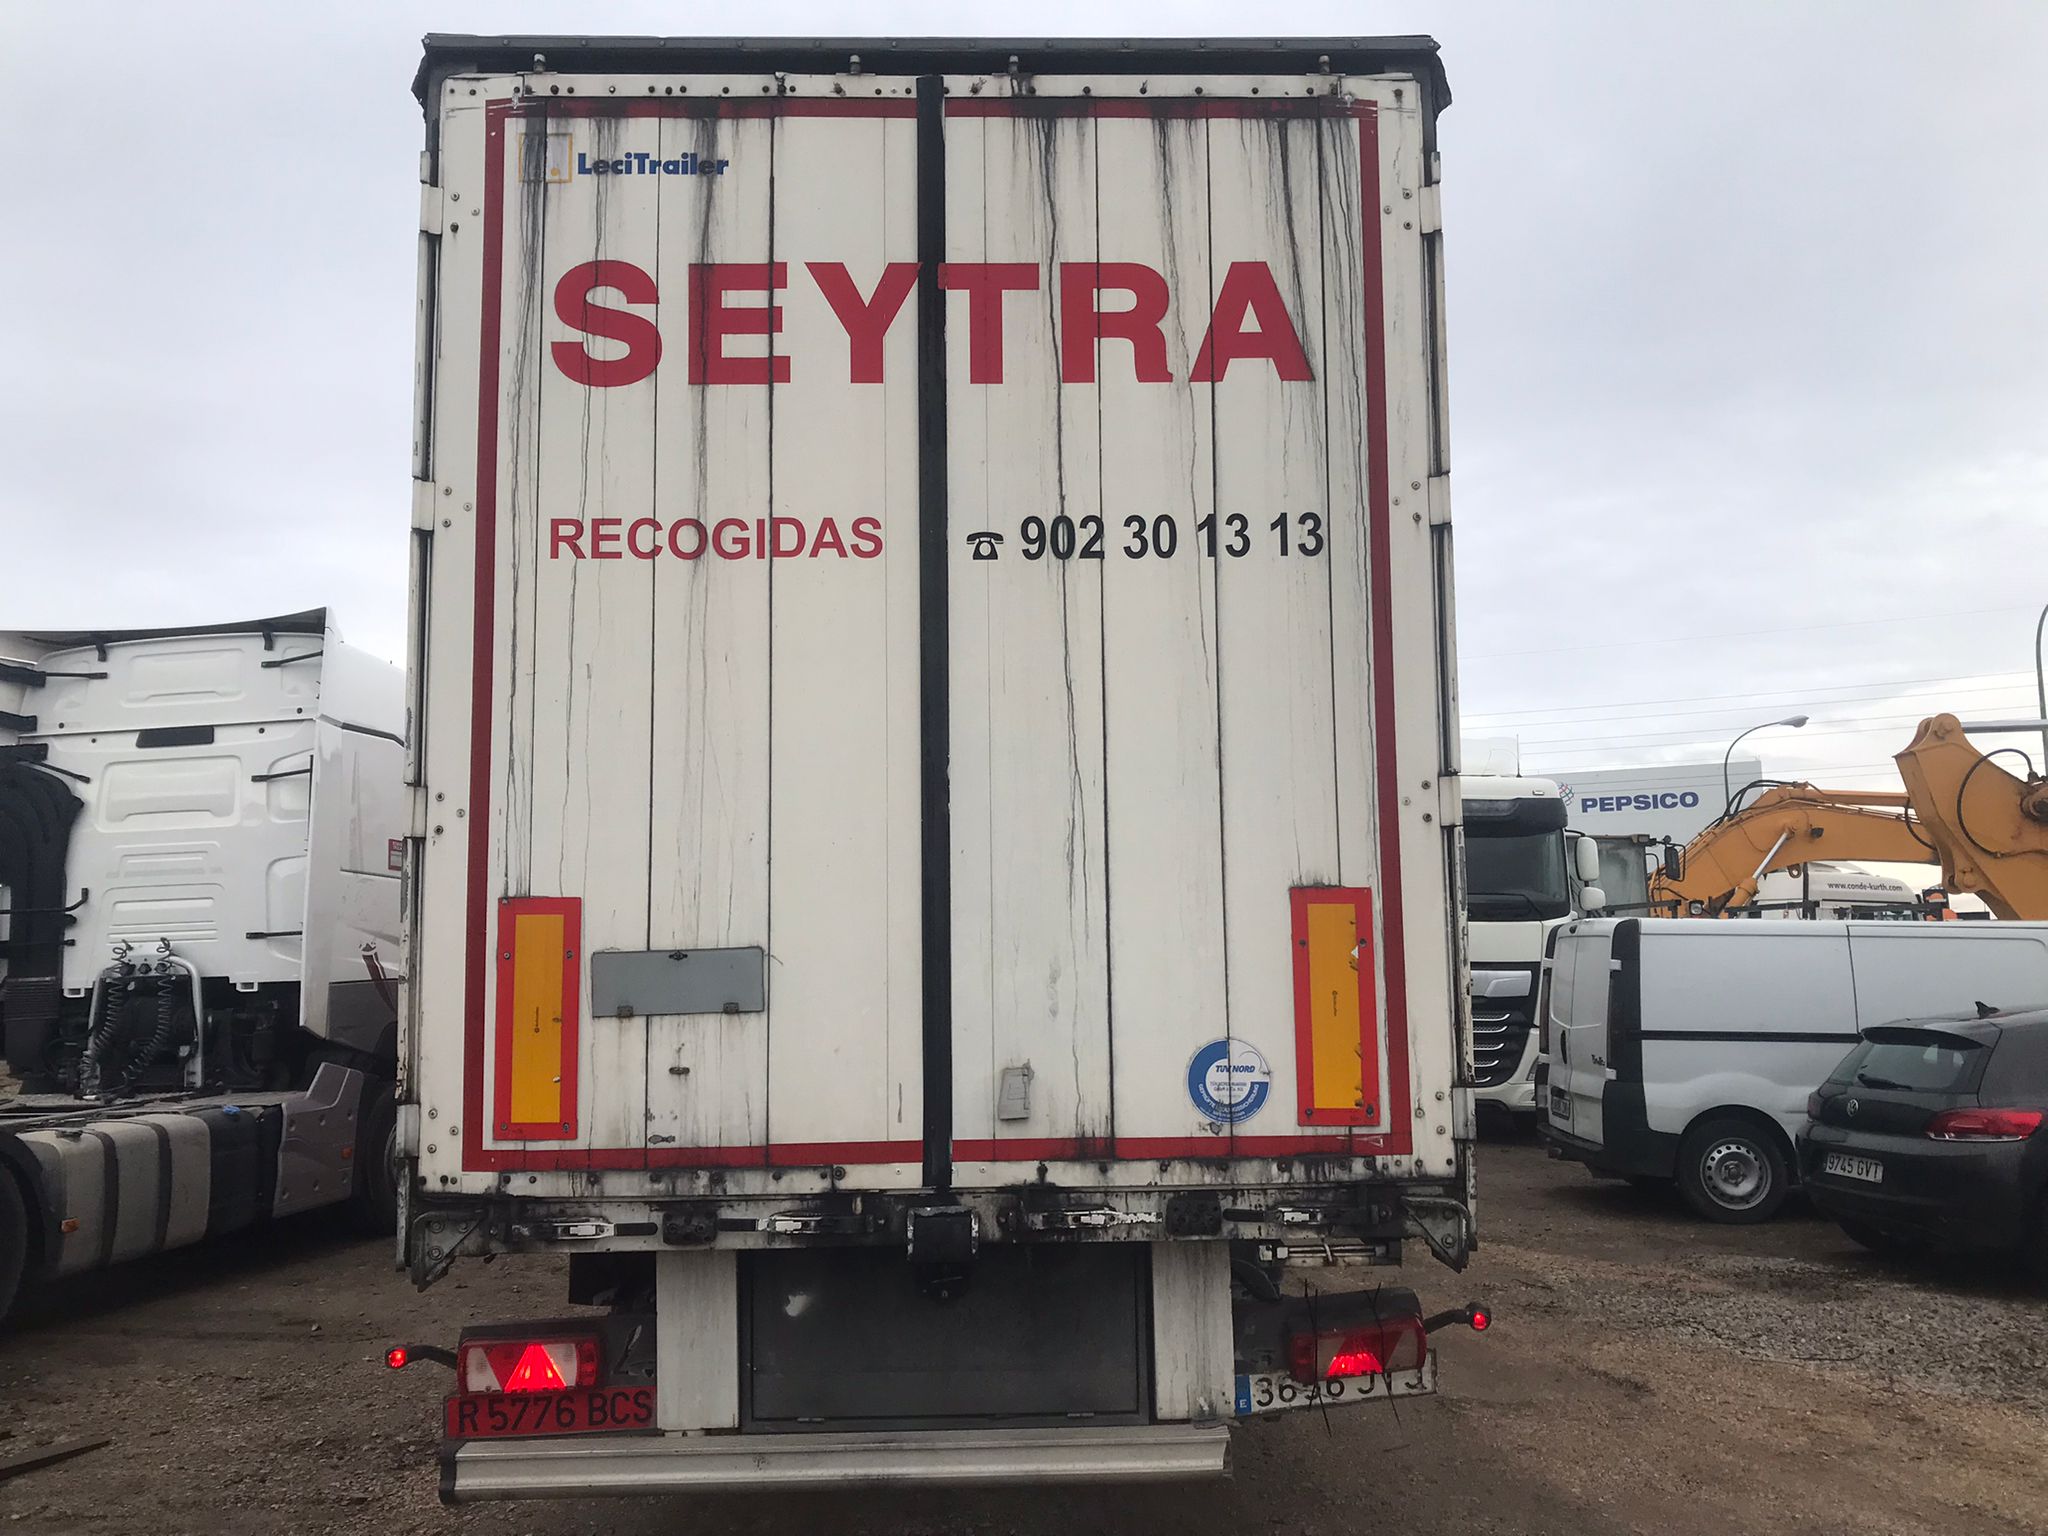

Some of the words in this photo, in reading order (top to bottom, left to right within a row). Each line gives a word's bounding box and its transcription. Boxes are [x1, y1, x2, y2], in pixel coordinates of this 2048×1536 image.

[577, 152, 730, 175] LeciTrailer
[551, 259, 1315, 386] SEYTRA
[550, 516, 884, 560] RECOGIDAS
[1020, 515, 1106, 560] 902
[1123, 514, 1179, 559] 30
[1196, 513, 1251, 558] 13
[1270, 512, 1325, 557] 13
[1581, 791, 1699, 814] PEPSICO
[1827, 881, 1904, 892] www.conde-kurth.com
[1232, 1065, 1256, 1073] NORD
[1828, 1155, 1854, 1174] 9745
[1856, 1160, 1881, 1179] GVT
[458, 1401, 479, 1433] R
[488, 1396, 576, 1431] 5776
[588, 1391, 653, 1425] BCS
[1239, 1399, 1247, 1408] E
